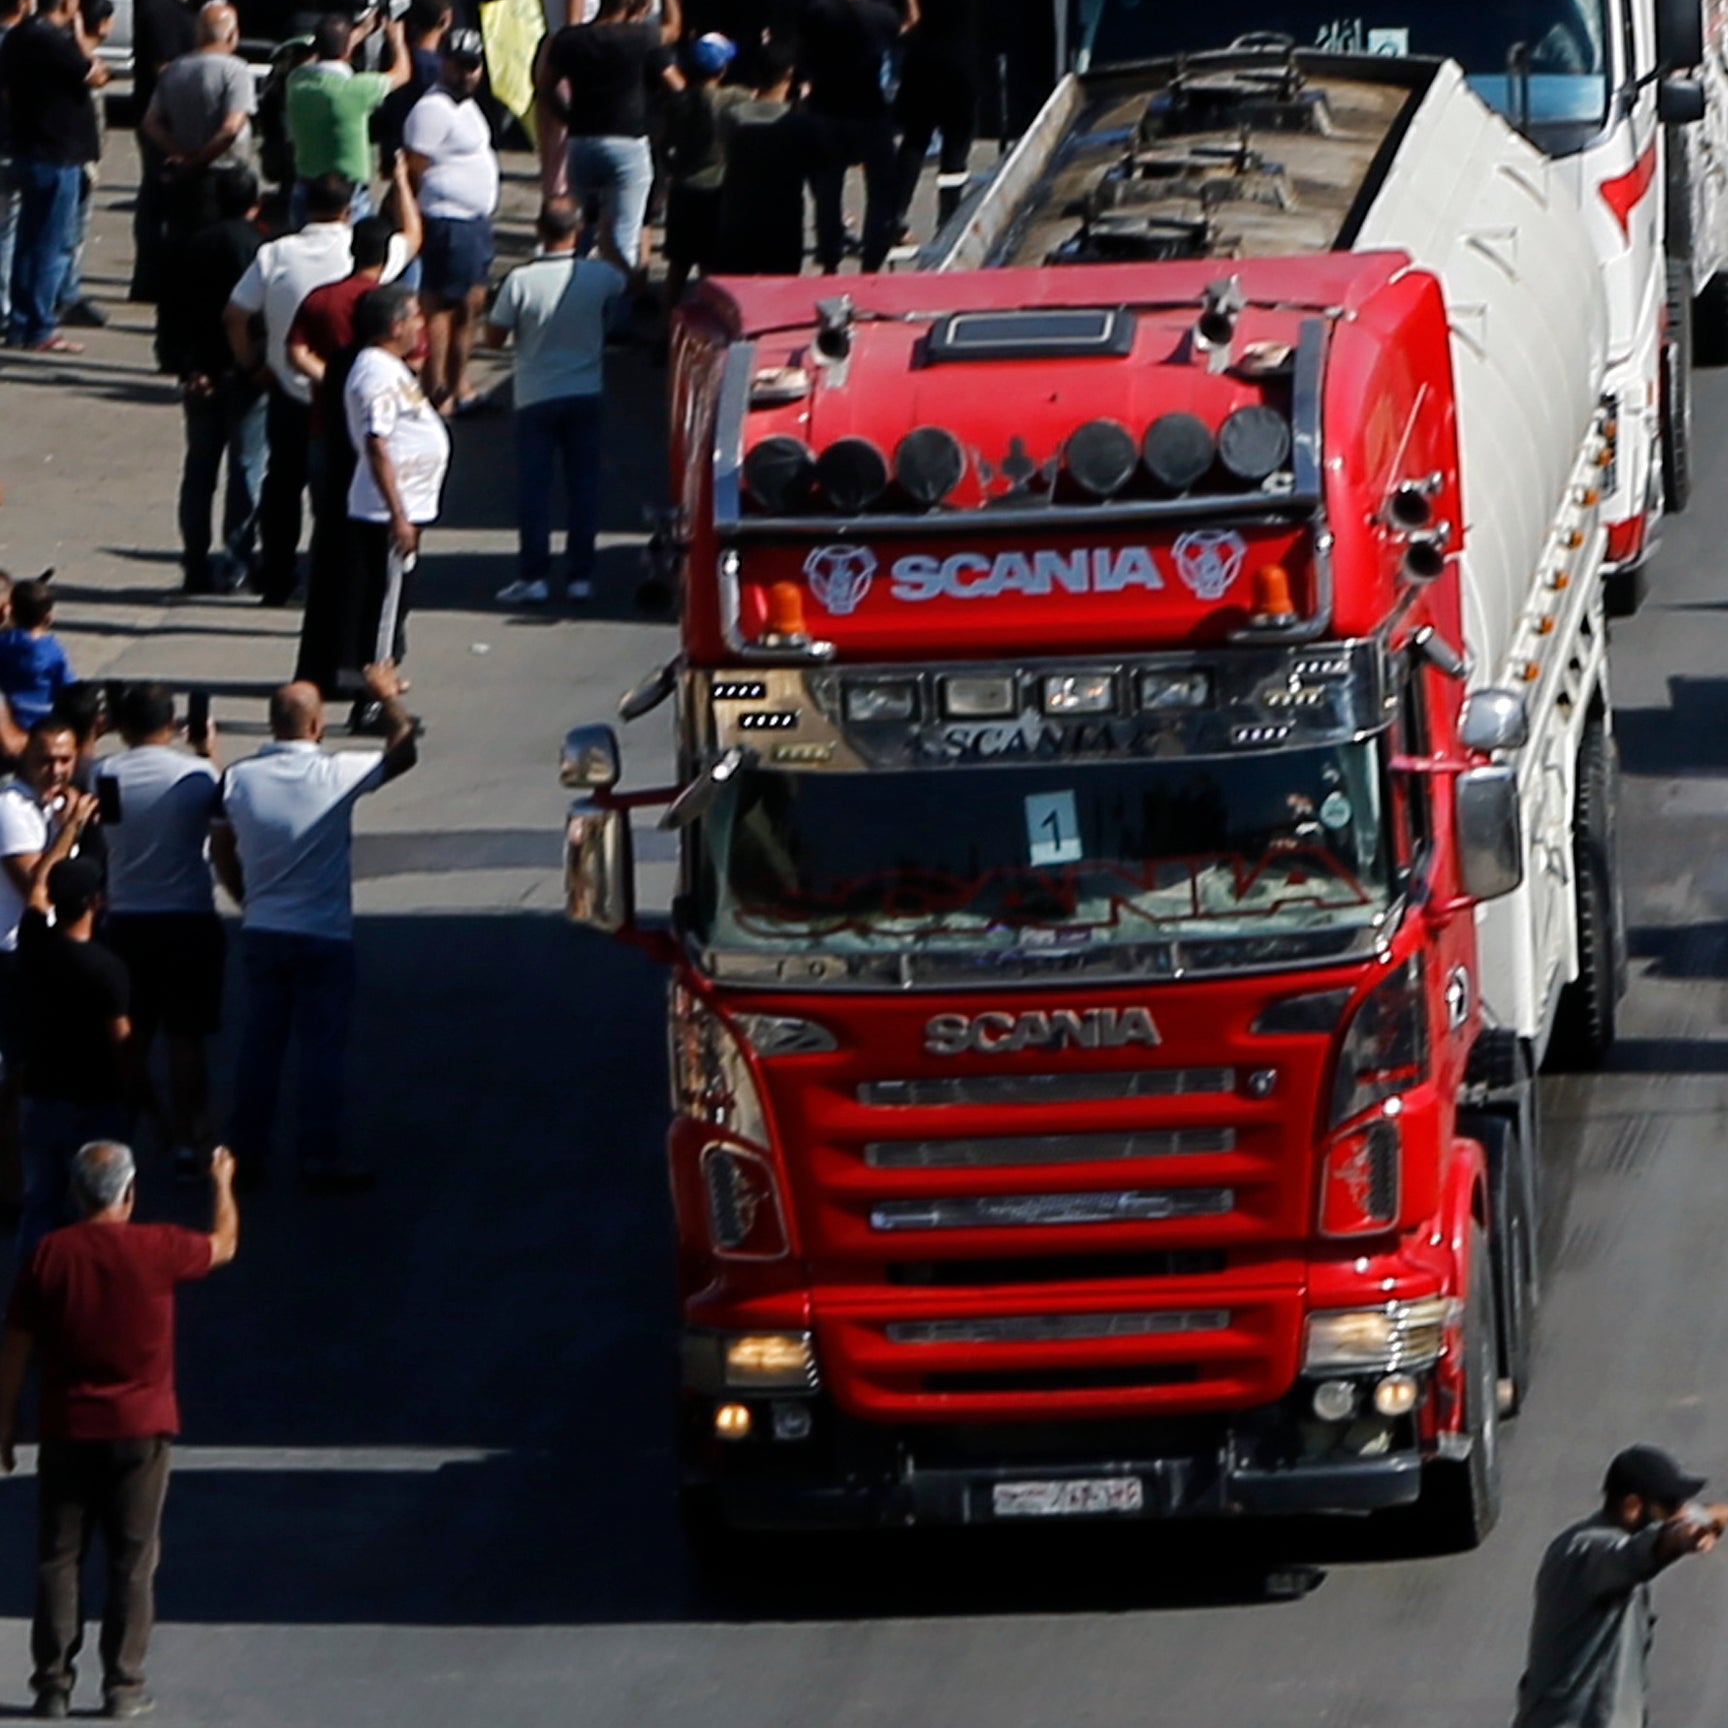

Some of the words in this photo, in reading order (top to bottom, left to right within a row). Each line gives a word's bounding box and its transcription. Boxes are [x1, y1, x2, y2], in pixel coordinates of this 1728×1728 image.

[890, 546, 1164, 602] SCANIA
[1040, 808, 1061, 853] 1
[924, 1005, 1164, 1055] SCANIA
